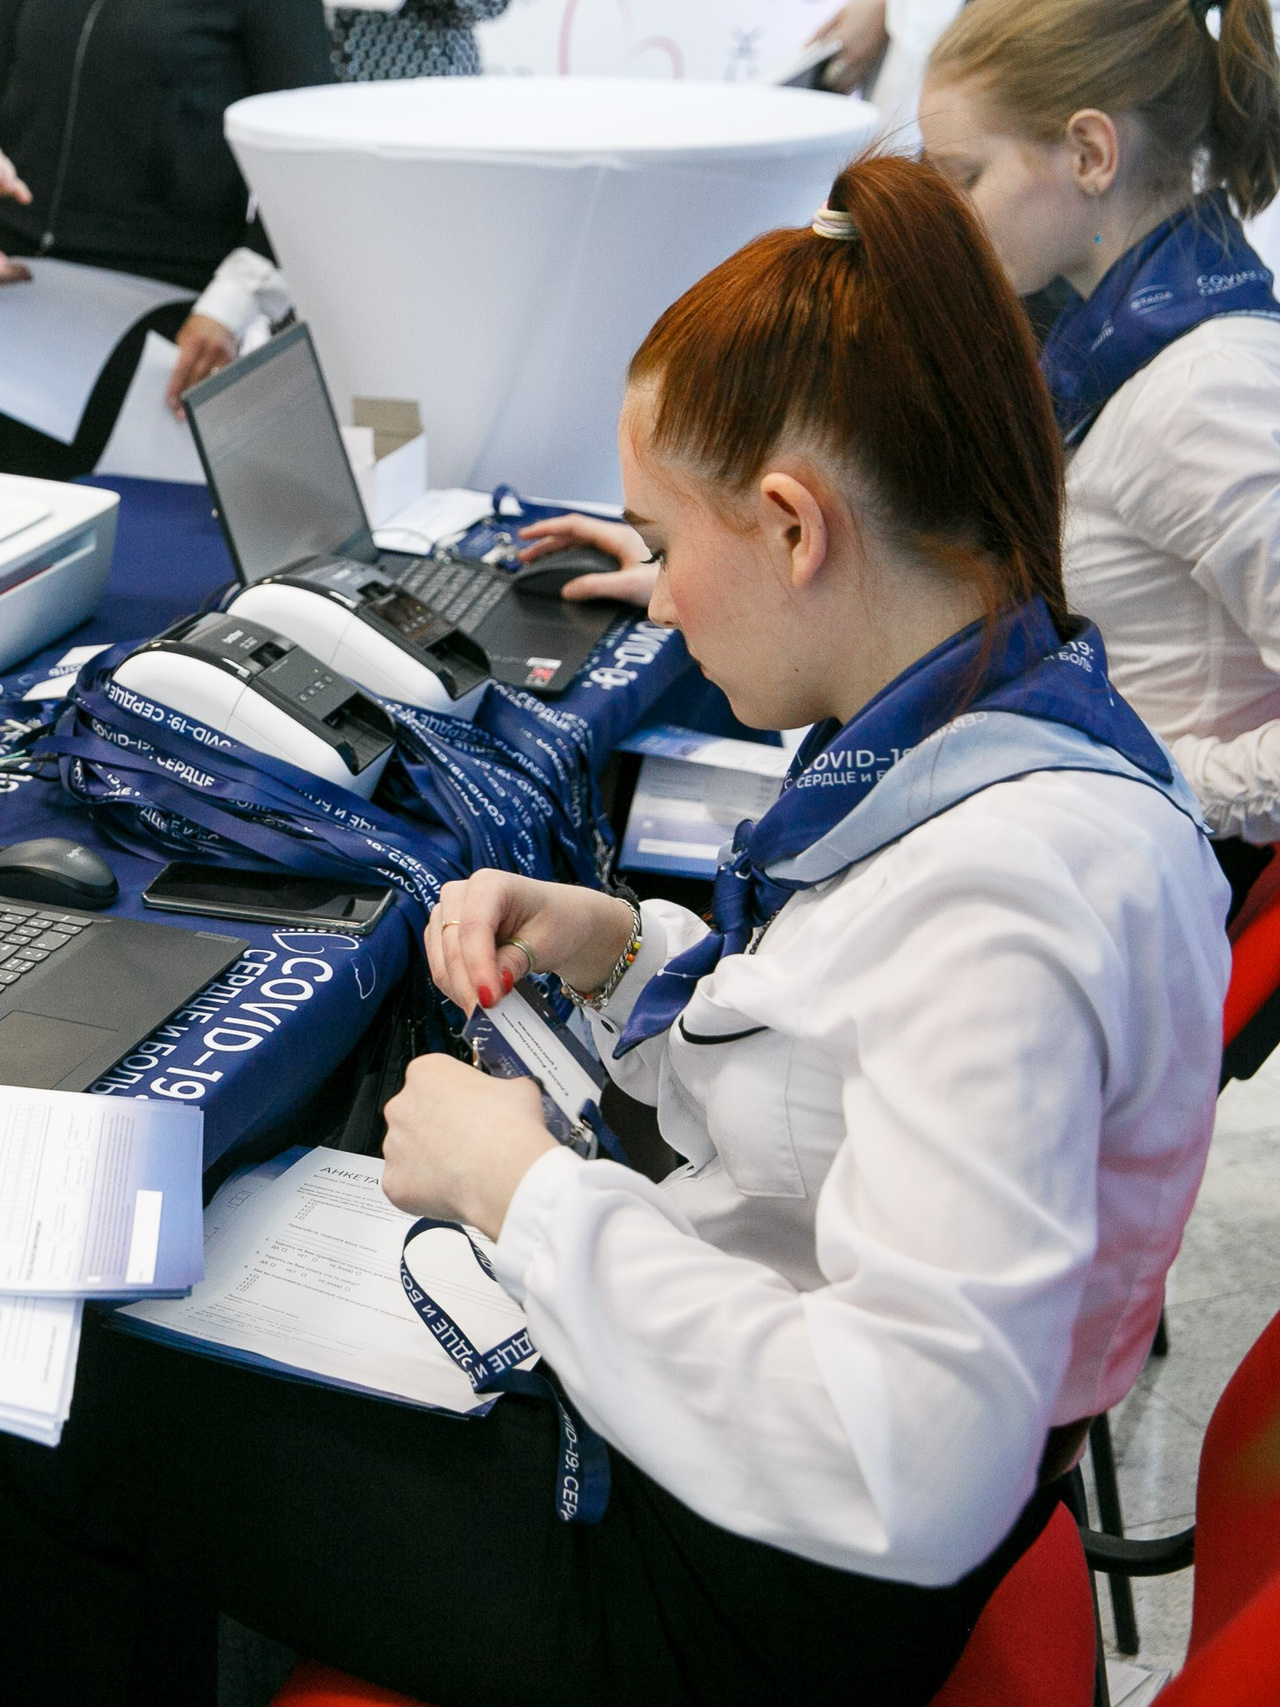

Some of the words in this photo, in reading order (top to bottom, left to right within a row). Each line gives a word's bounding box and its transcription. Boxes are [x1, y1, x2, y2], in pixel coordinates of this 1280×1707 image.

[108, 684, 165, 722] СЕРДЦЕ
[448, 762, 506, 827] COVID-19:
[796, 771, 857, 789] СЕРДЦЕ
[174, 949, 278, 1025] СЕРДЦЕ
[90, 1040, 178, 1095] БОЛЬ
[320, 1166, 380, 1186] АНКЕТА
